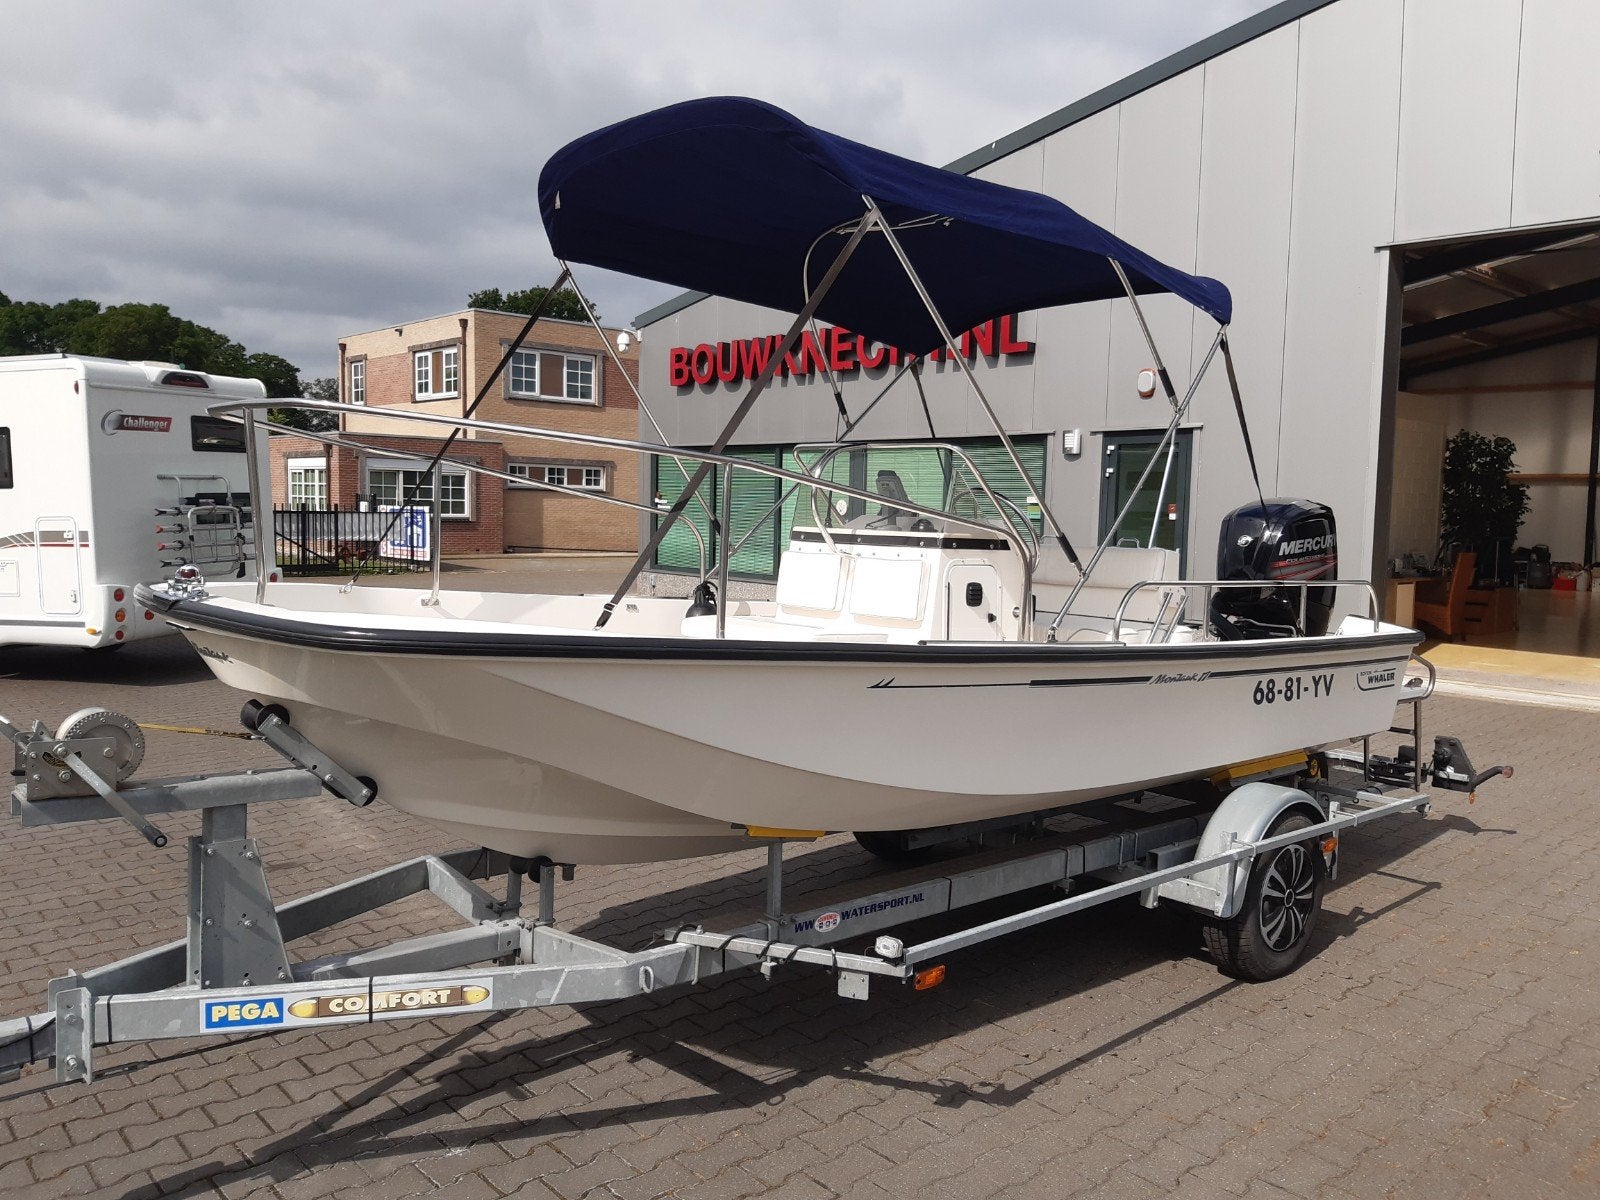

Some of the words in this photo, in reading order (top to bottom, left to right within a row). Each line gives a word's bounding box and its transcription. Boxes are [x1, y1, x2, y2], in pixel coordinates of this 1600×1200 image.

[670, 315, 1035, 387] BOUWKNEC.NL
[123, 416, 168, 432] Challenger
[1253, 674, 1334, 706] 68-81-YV
[1367, 672, 1395, 684] WHALER
[841, 893, 925, 921] WATERSPORT.NL
[211, 1001, 280, 1023] PEGA
[328, 989, 451, 1013] COMFORT
